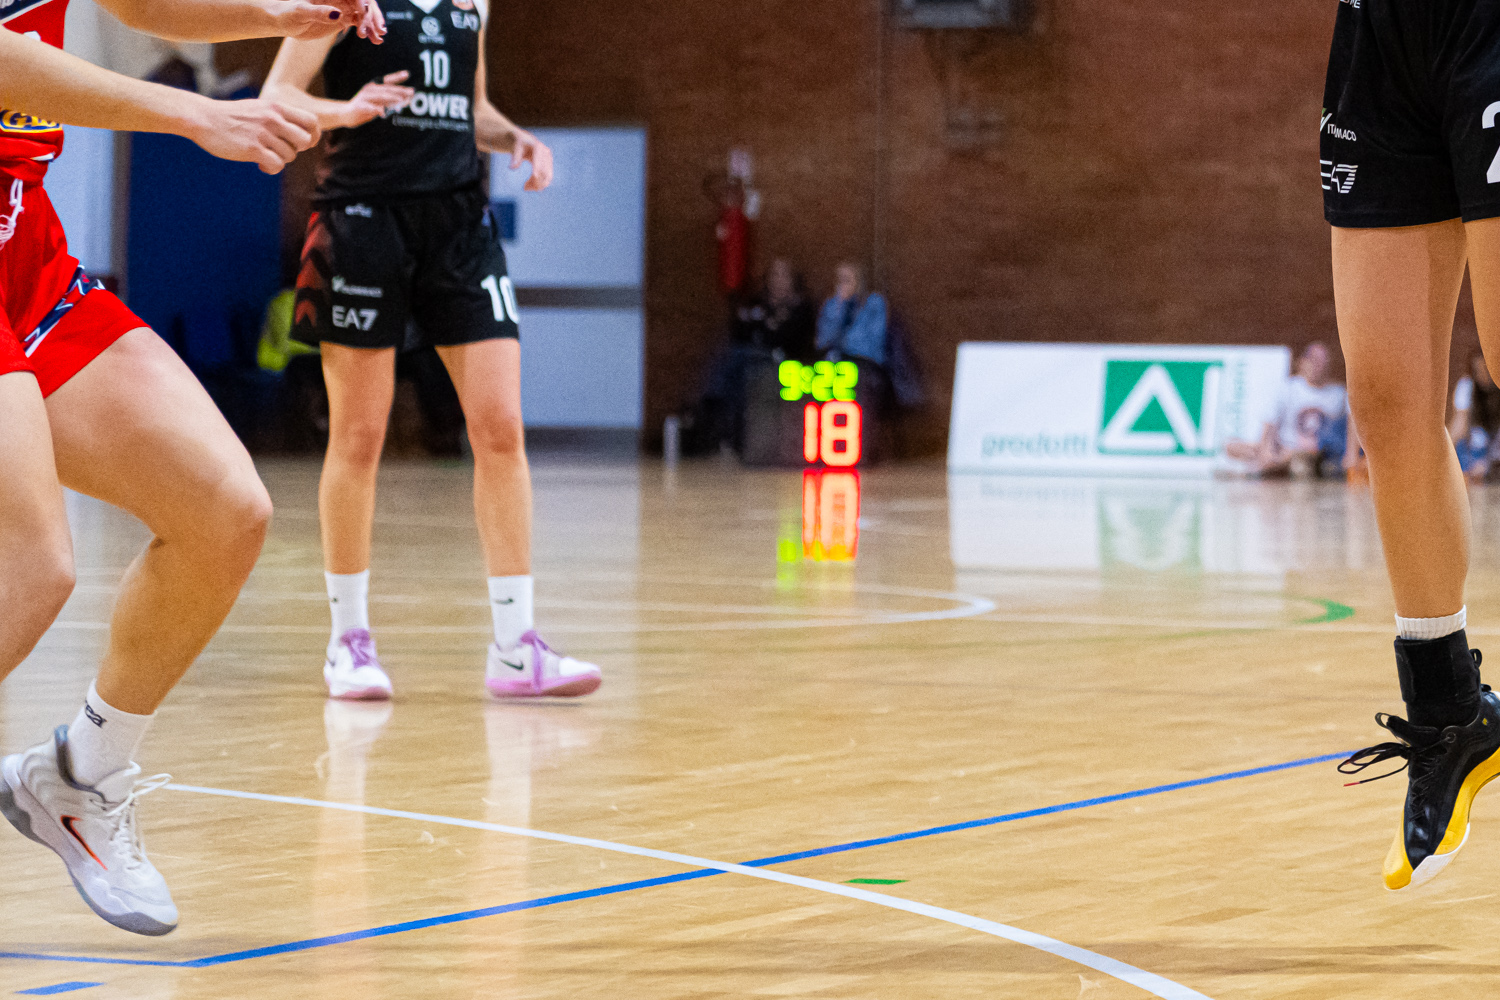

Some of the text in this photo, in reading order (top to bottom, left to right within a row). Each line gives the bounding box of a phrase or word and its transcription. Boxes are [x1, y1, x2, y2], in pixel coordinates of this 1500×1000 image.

[419, 49, 451, 89] 10
[332, 305, 378, 331] EA7
[480, 274, 521, 324] 10
[803, 398, 863, 468] 18
